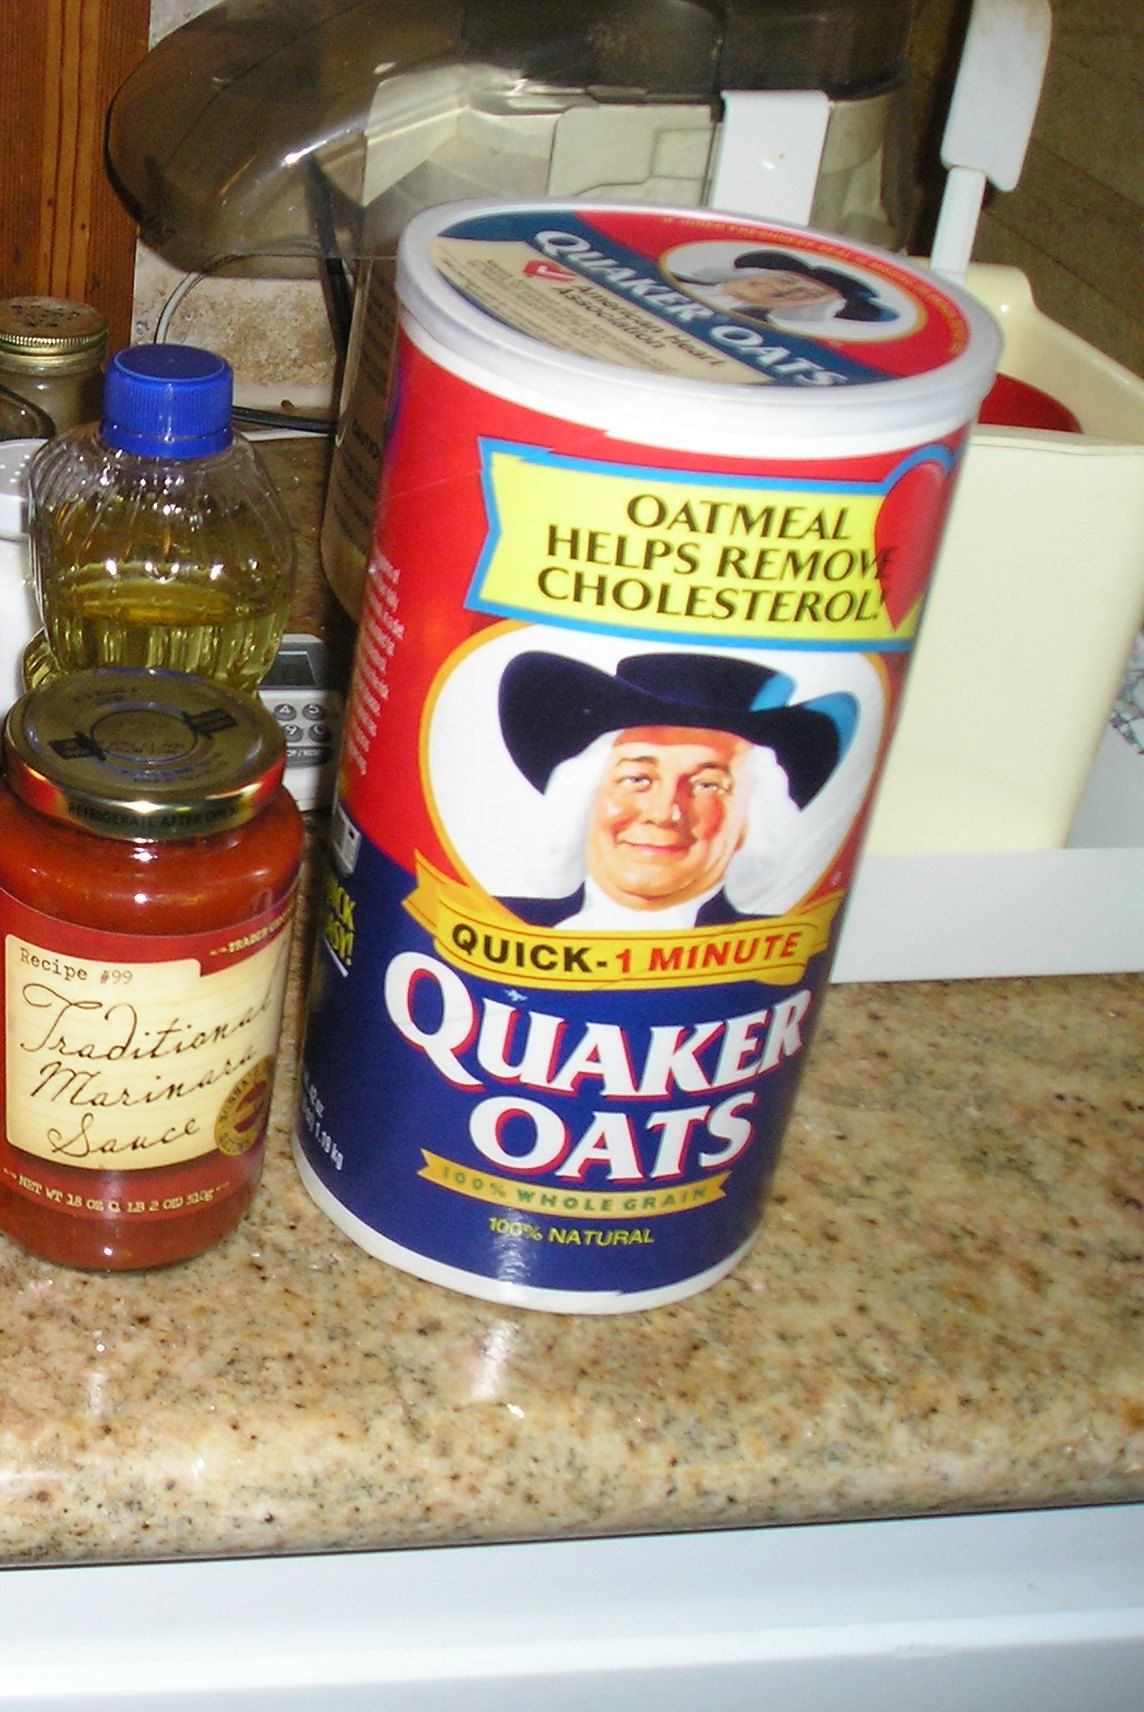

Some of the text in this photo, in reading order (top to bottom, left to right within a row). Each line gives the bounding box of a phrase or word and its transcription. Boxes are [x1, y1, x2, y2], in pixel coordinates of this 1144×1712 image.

[535, 230, 714, 323] QUAKER
[710, 325, 849, 386] OATS
[626, 494, 853, 540] OATMEAL
[547, 524, 700, 575] HELPS
[19, 947, 133, 985] Recipe #99
[647, 929, 804, 973] MINUTE
[383, 951, 812, 1098] QUAKER
[31, 1046, 257, 1107] Marinara
[47, 1112, 200, 1158] Sauce
[468, 1091, 757, 1181] OATS
[19, 1174, 44, 1195] NET
[46, 1187, 63, 1203] WT
[442, 1167, 707, 1212] 100% WHOLE GRAIN
[489, 1215, 655, 1247] 100% NATURAL
